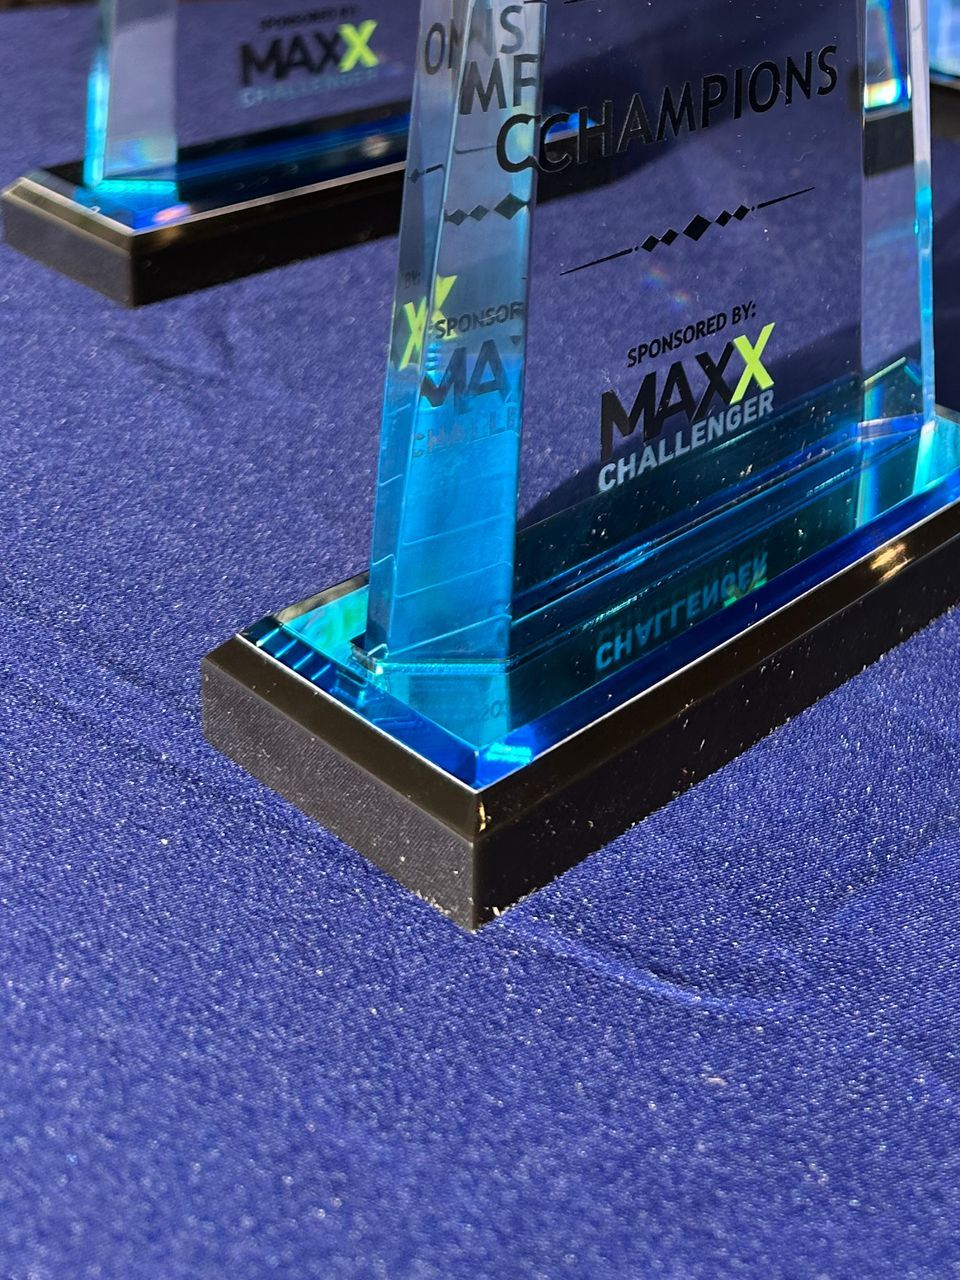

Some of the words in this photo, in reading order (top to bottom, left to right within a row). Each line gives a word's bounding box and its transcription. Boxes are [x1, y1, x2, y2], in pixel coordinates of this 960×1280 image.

[239, 19, 380, 88] MAXX
[626, 311, 728, 368] SPONSORED
[731, 300, 757, 325] BY:
[600, 321, 776, 460] MAXX
[598, 389, 775, 493] CHALLENGER
